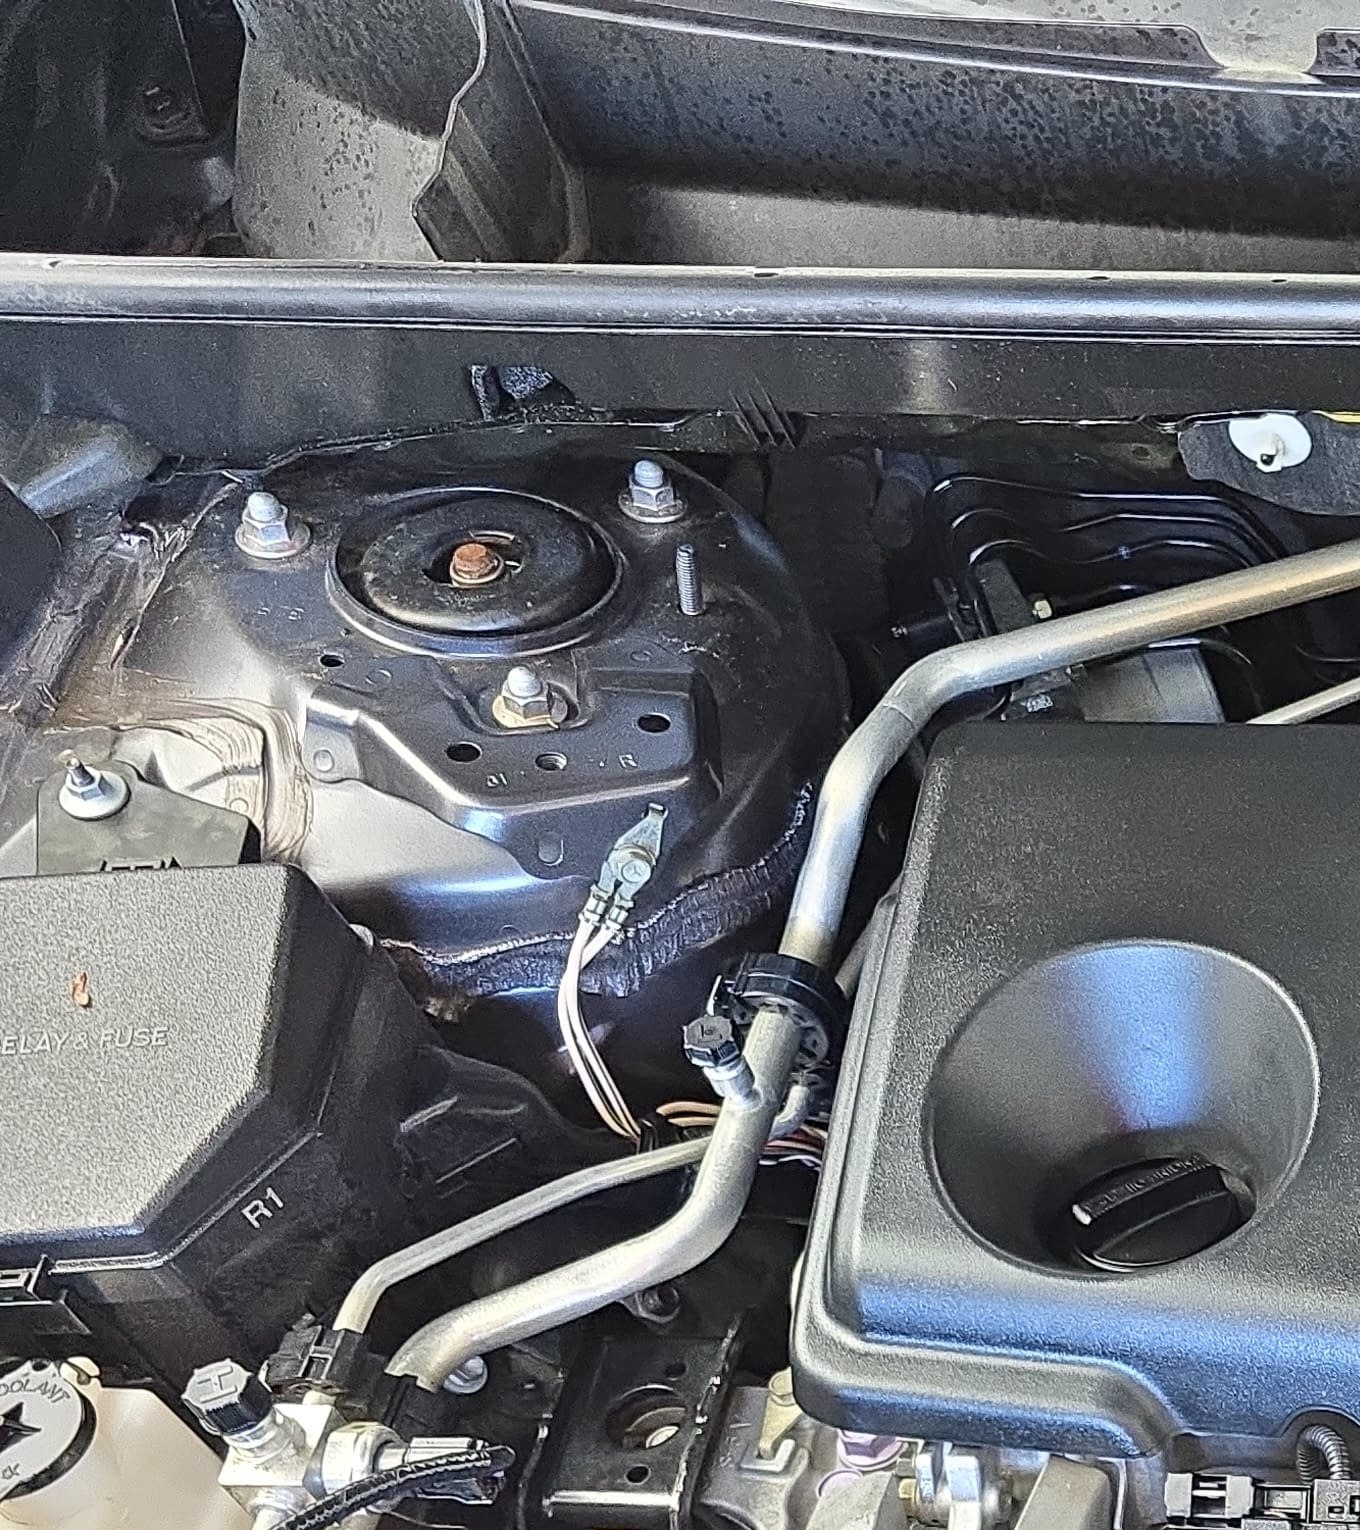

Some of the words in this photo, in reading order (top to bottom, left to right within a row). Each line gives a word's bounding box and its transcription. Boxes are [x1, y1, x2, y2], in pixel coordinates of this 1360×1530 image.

[0, 1029, 71, 1055] ELAY
[74, 1031, 90, 1051] &
[100, 1024, 170, 1050] FUSE
[241, 1187, 284, 1229] R1
[0, 1379, 72, 1404] OOLANT
